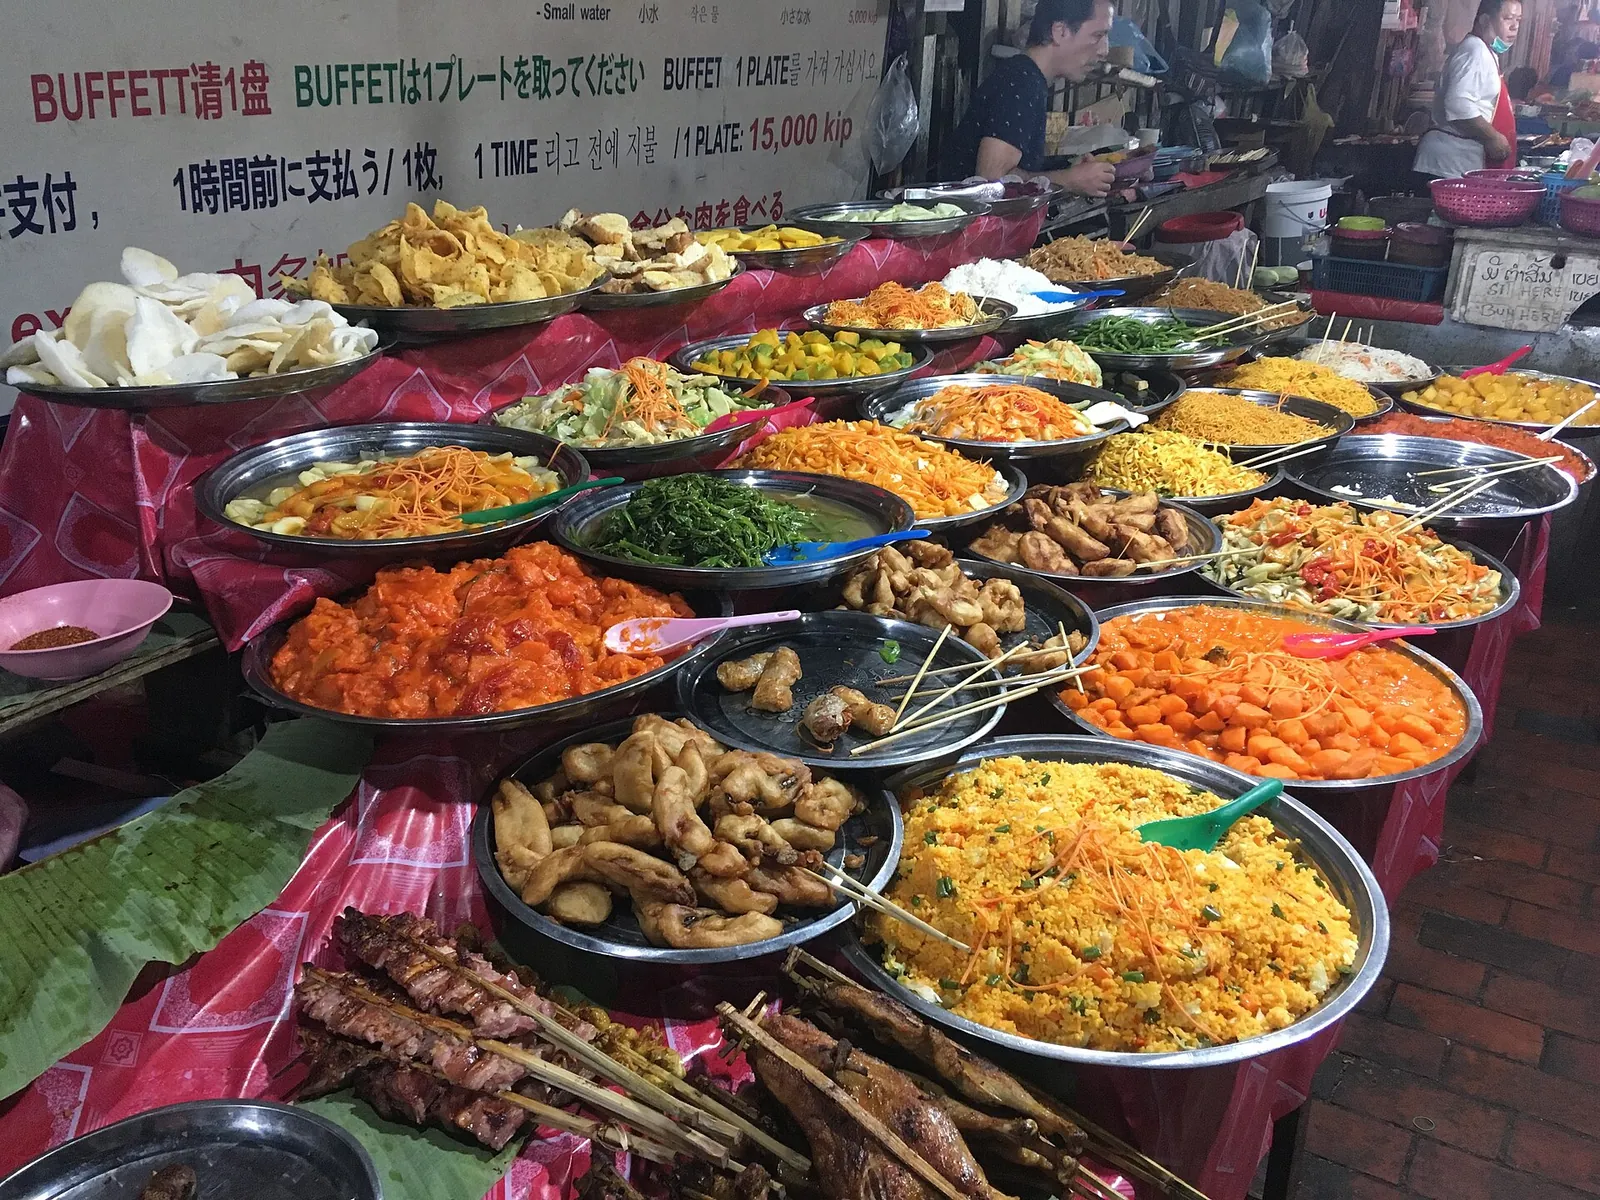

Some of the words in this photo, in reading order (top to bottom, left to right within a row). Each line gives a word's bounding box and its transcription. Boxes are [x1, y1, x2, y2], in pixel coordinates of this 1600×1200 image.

[580, 5, 611, 20] water
[638, 3, 659, 24] 小水
[690, 4, 708, 24] 작은
[710, 5, 720, 24] 물
[780, 7, 811, 25] 小さな水
[848, 10, 868, 24] 5,000
[294, 53, 645, 108] BUFFETは1プレートを取ってください
[663, 56, 722, 91] BUFFET
[736, 57, 743, 87] 1
[30, 59, 272, 123] BUFFETT请1盘
[474, 143, 483, 179] 1
[490, 138, 538, 177] TIME
[545, 131, 580, 175] 리고
[587, 128, 619, 171] 전에
[626, 125, 658, 167] 지불
[695, 122, 744, 157] PLATE:
[750, 113, 818, 155] 15,000
[823, 111, 853, 148] kip
[1520, 286, 1562, 300] HERE
[1519, 310, 1560, 324] HERE
